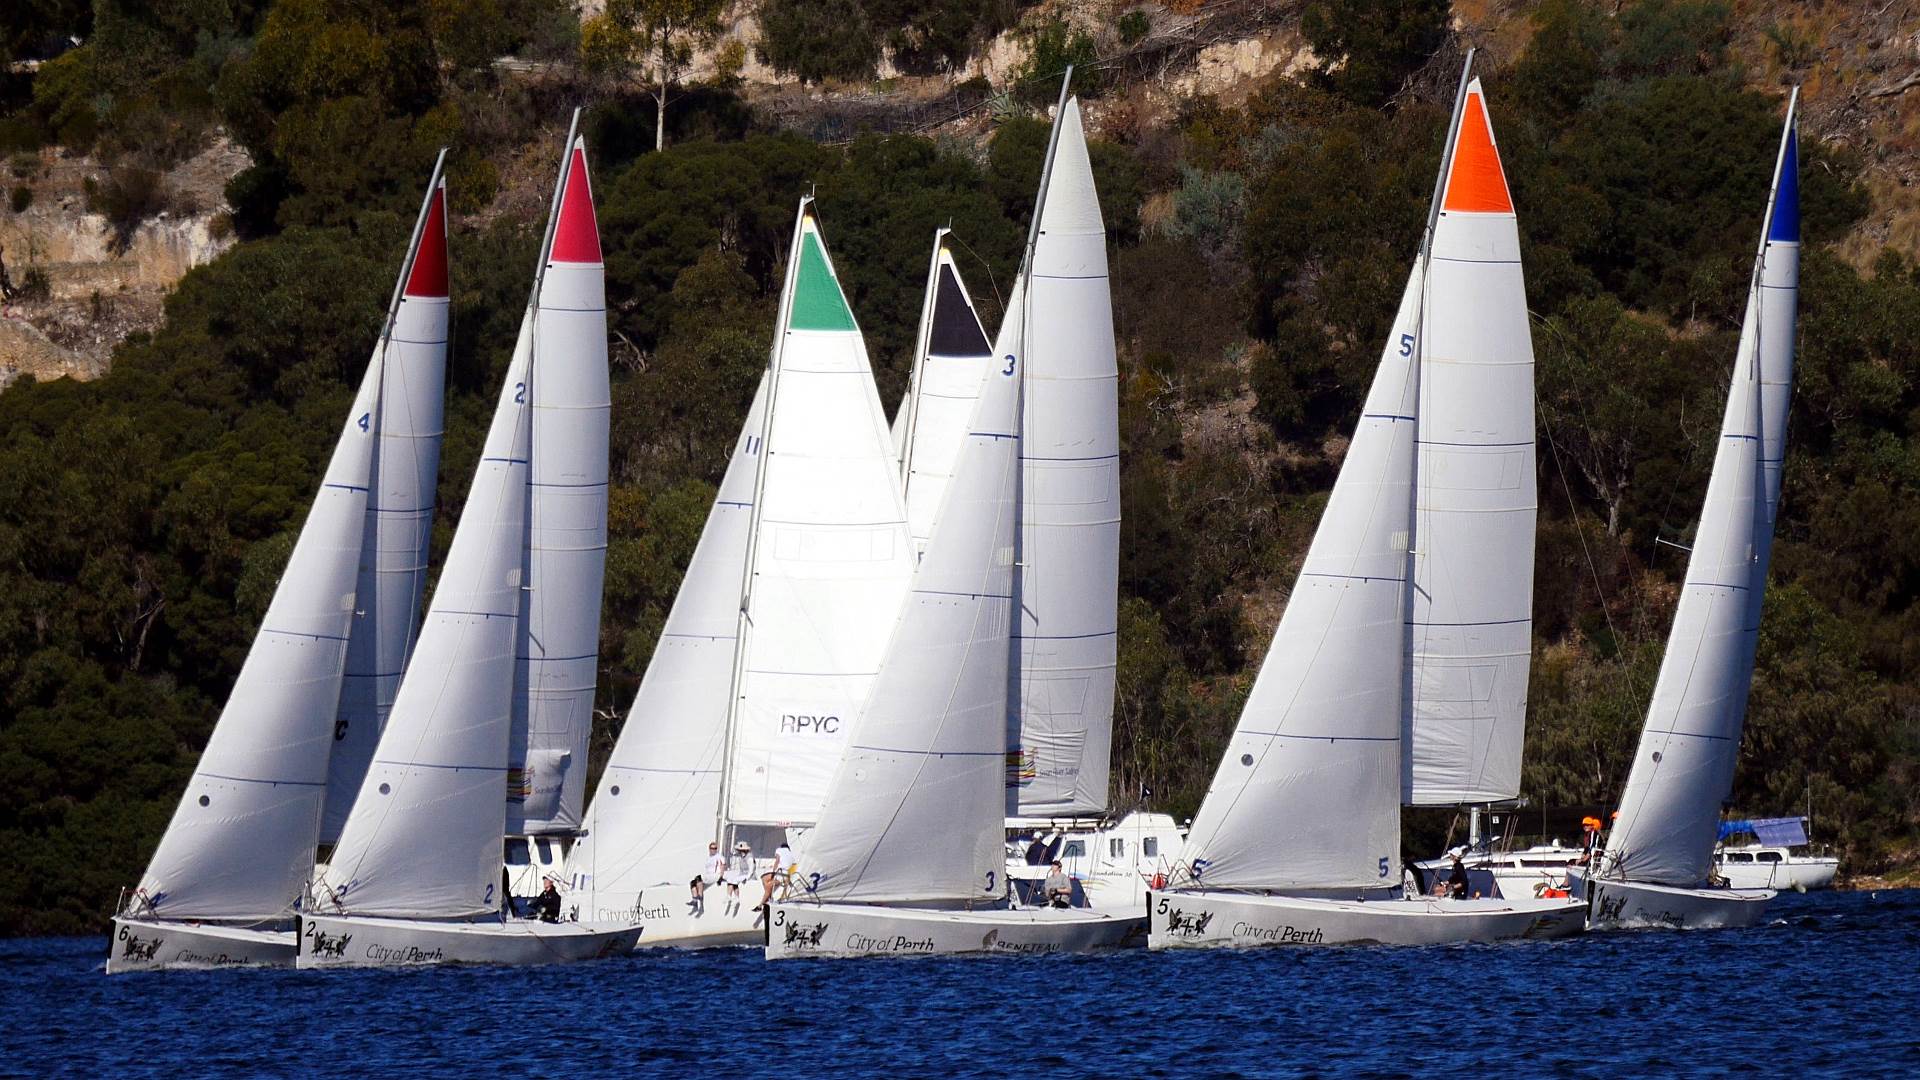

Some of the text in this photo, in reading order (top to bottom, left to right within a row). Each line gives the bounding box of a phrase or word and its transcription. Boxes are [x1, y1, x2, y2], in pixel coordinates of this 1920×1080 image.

[1398, 333, 1415, 357] 5
[1002, 354, 1016, 377] 3
[514, 382, 526, 404] 2
[357, 412, 371, 433] 4
[745, 435, 760, 455] 11
[780, 714, 840, 733] RPYC
[1379, 856, 1389, 878] 5
[805, 872, 821, 893] 3
[984, 871, 995, 892] 3
[483, 883, 494, 905] 2
[1157, 898, 1170, 915] 5
[774, 910, 785, 927] 3
[118, 925, 130, 941] 6
[305, 921, 316, 938] 2
[1232, 921, 1323, 943] City of Perth
[846, 933, 934, 951] City of Perth
[366, 944, 443, 962] City of Perth
